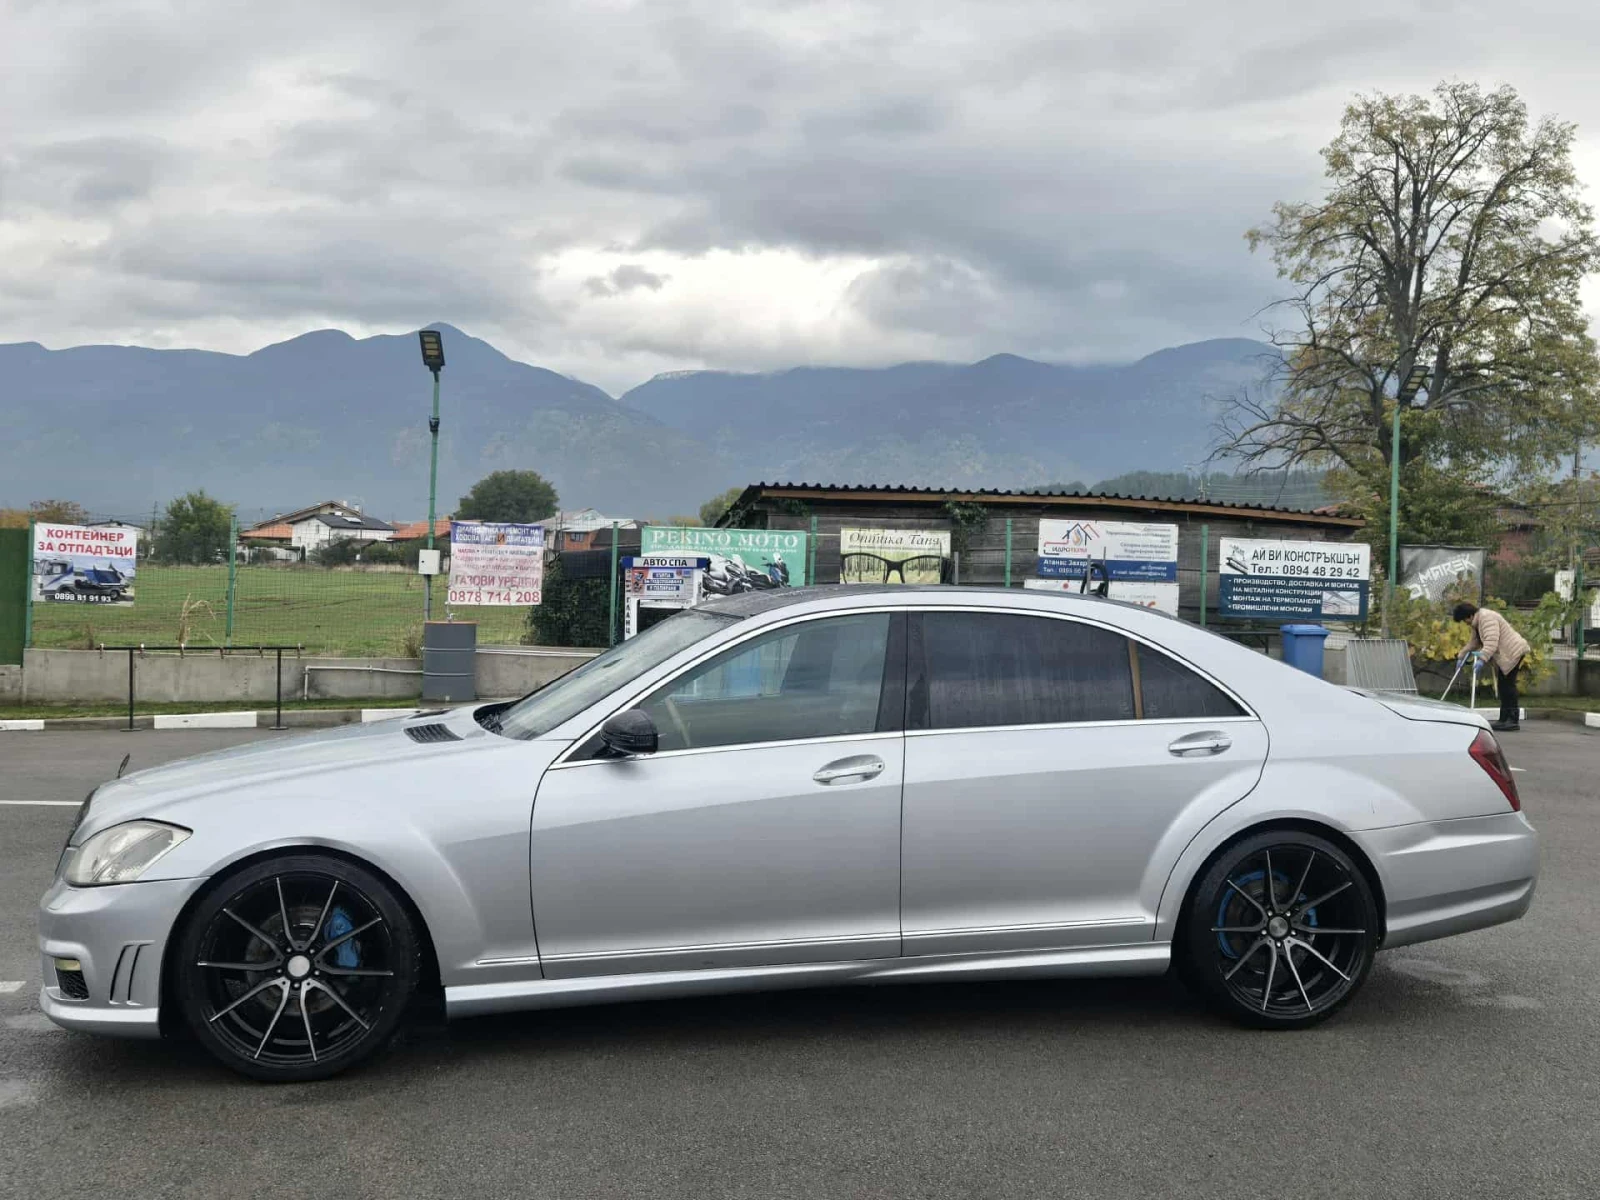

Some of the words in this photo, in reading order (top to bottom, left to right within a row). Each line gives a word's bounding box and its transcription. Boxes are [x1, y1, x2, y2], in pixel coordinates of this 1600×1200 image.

[46, 529, 124, 542] КОНТЕЙНЕР
[498, 534, 505, 542] И
[652, 530, 731, 546] PEKINO
[738, 532, 799, 548] MOTO
[909, 534, 940, 546] Таня
[38, 541, 53, 551] ЗА
[58, 543, 132, 556] ОТПАДЪЦИ
[1252, 548, 1266, 560] АЙ
[1269, 550, 1281, 561] ВИ
[1284, 551, 1360, 564] КОНСТРЪКШЪН
[1251, 563, 1279, 574] Тел.:
[1282, 565, 1309, 575] 0894
[1312, 566, 1326, 576] 48
[1330, 567, 1342, 577] 29
[1346, 568, 1360, 577] 42
[455, 575, 495, 586] ГАЗОВИ
[450, 590, 482, 602] 0878
[487, 591, 511, 603] 714
[516, 591, 539, 603] 208
